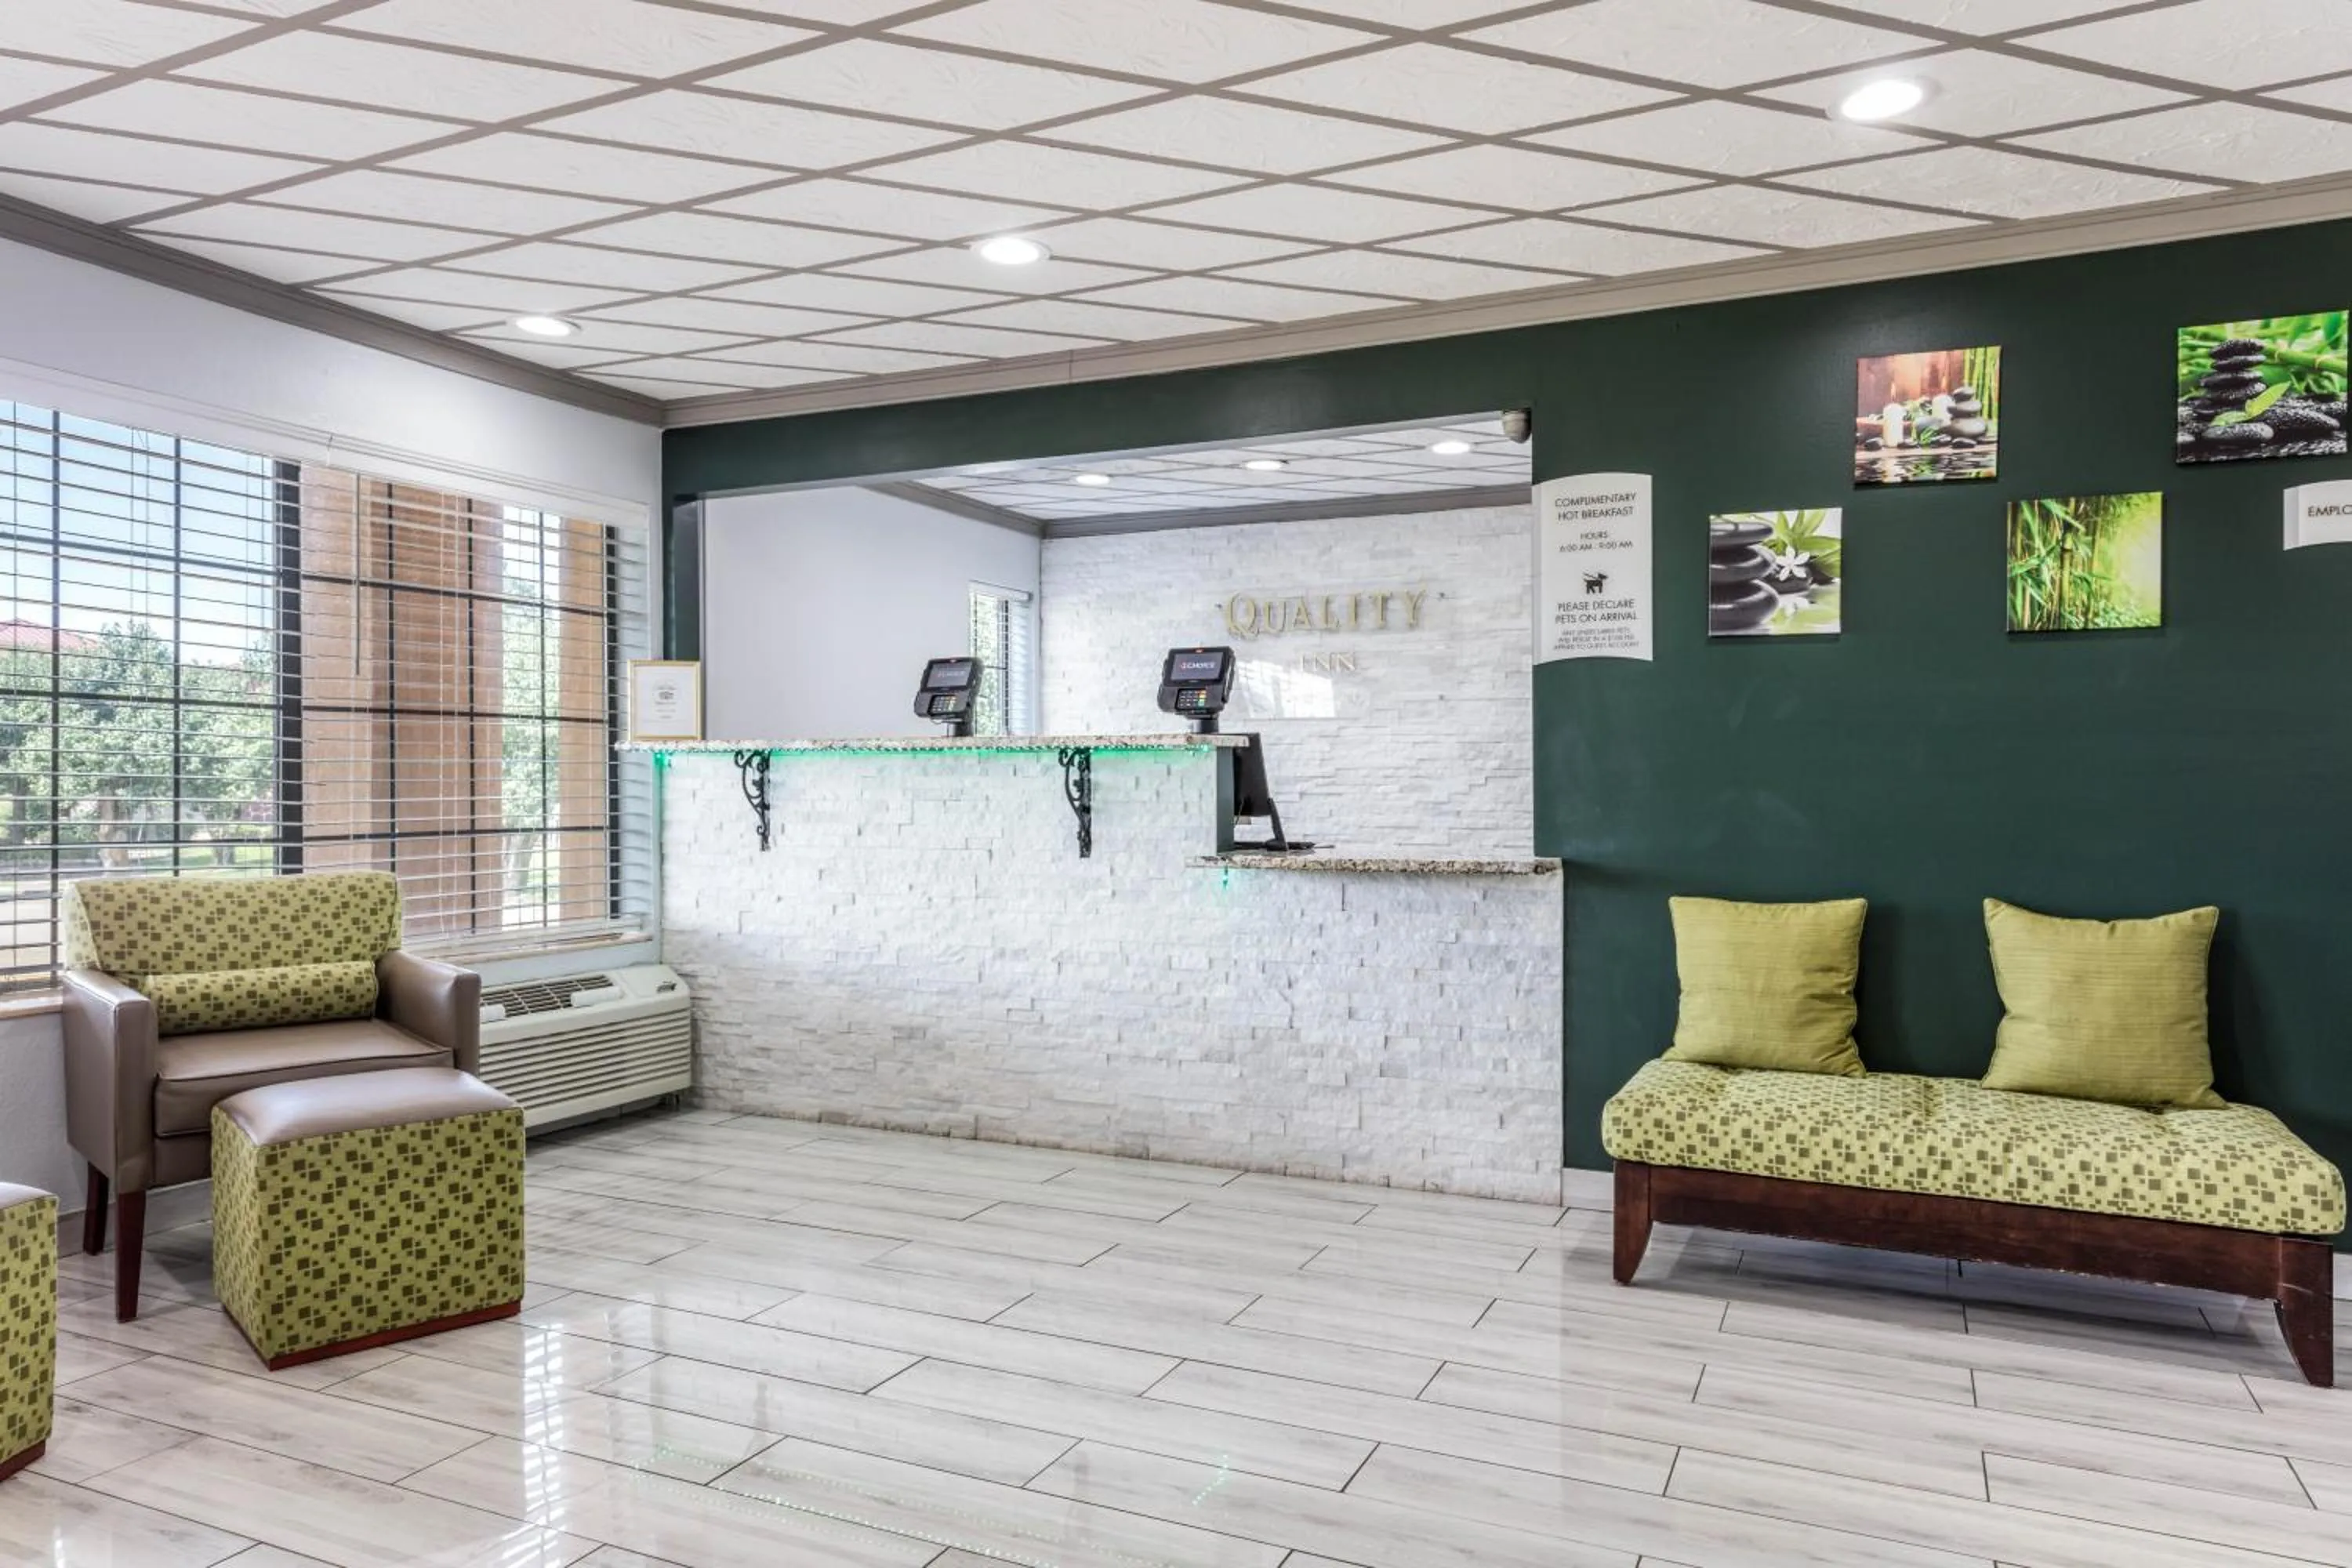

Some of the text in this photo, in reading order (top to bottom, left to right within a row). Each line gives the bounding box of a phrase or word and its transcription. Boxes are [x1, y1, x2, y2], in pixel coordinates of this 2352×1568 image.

[1555, 492, 1636, 507] COMPLIMENTARY
[1558, 506, 1634, 521] HOT BREAKFAST
[1580, 530, 1607, 539] HOURS
[1579, 543, 1592, 551] AM
[1557, 598, 1635, 612] PLEASE DECLARE
[1226, 590, 1425, 641] QUALITY
[1555, 611, 1636, 624] PETS ON ARRIVAL
[1301, 652, 1356, 671] INN
